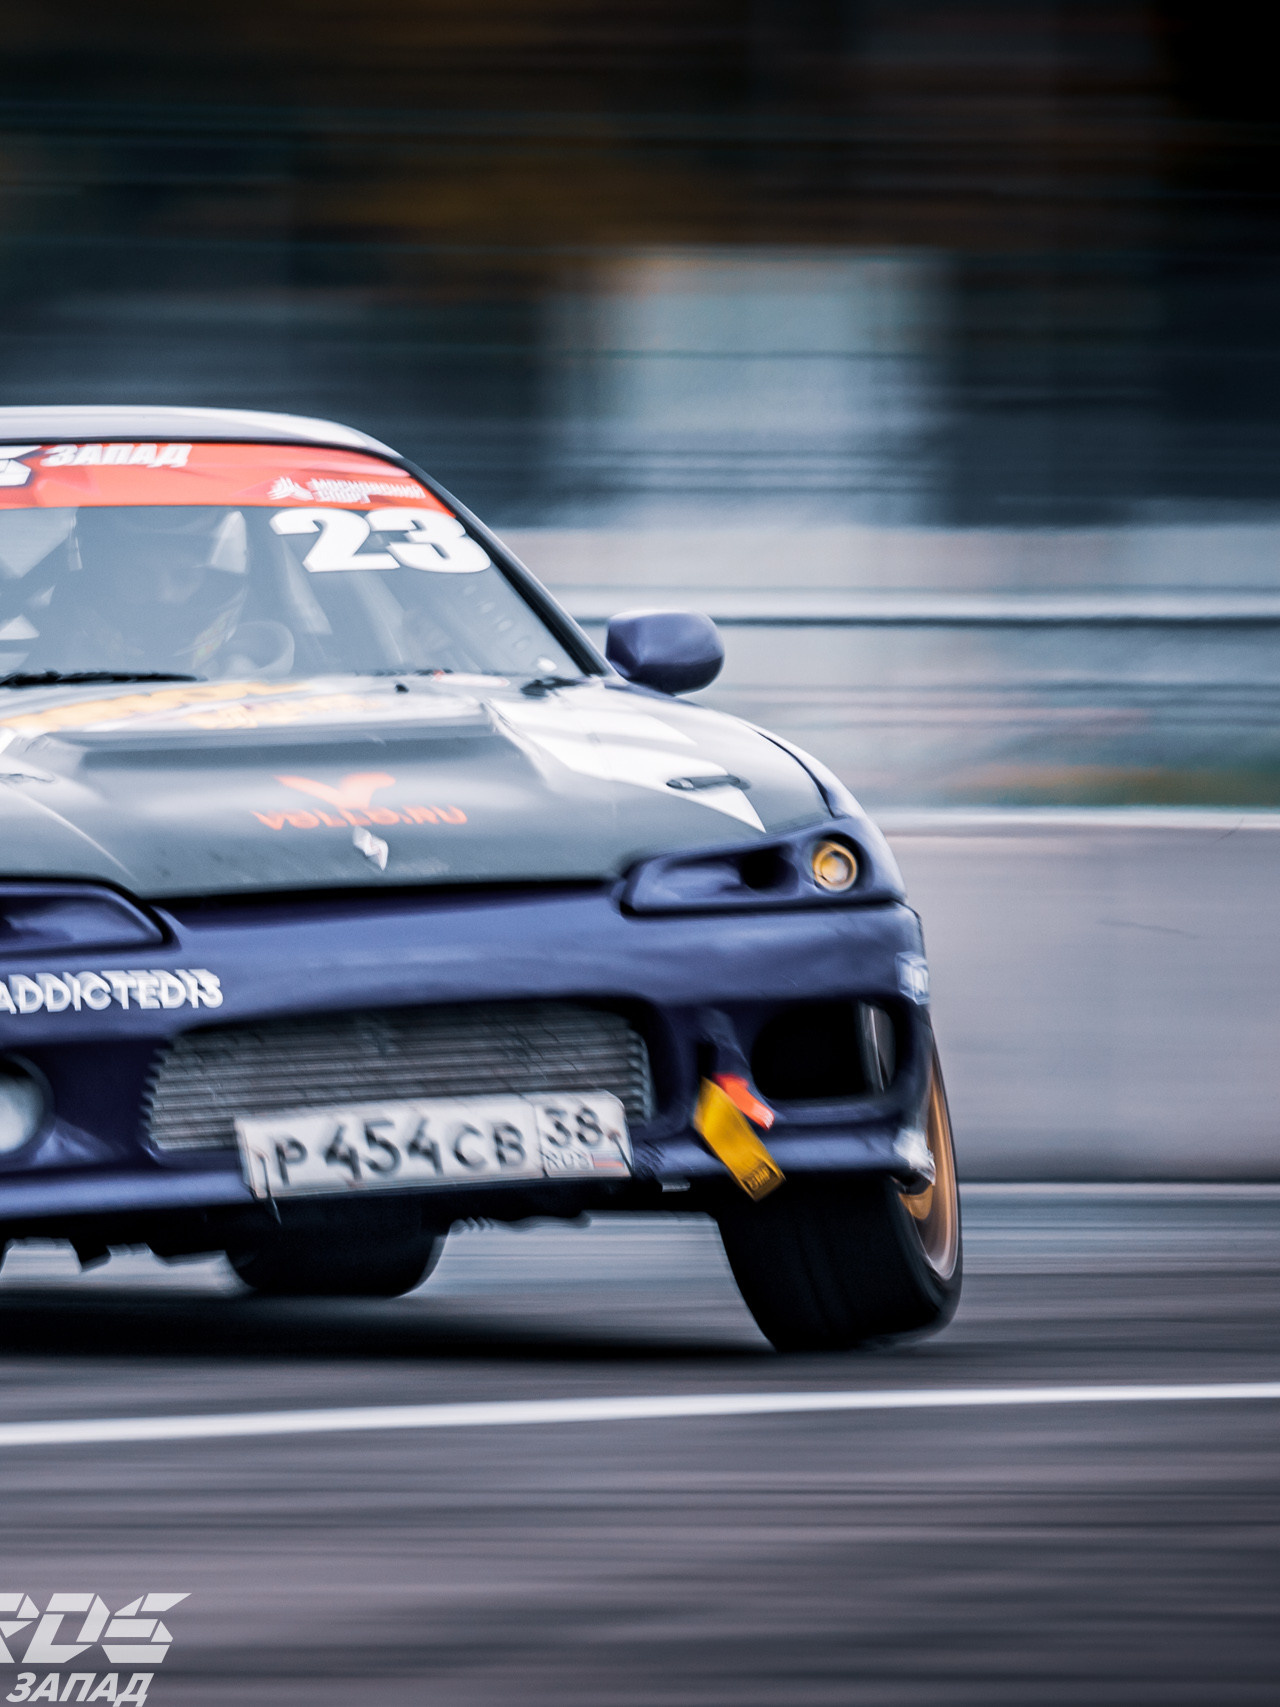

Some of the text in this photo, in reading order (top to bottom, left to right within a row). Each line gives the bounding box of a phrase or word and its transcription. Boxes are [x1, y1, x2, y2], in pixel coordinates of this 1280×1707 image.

[40, 442, 193, 469] ЗАПАД
[270, 507, 491, 573] 23
[543, 1107, 605, 1148] 38
